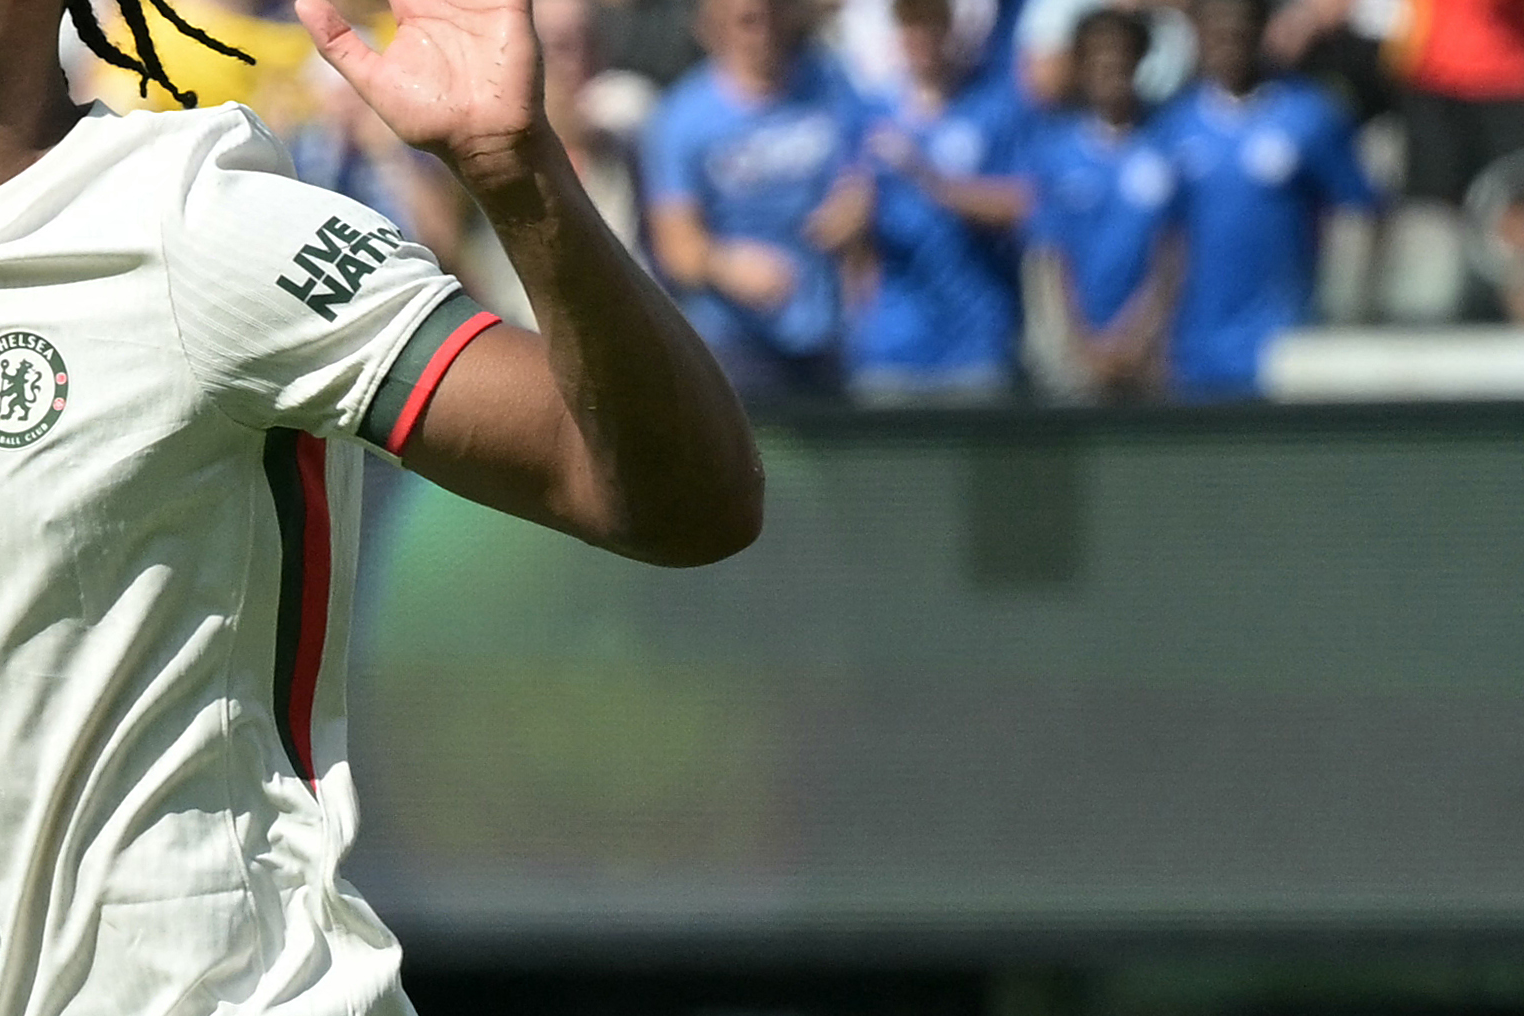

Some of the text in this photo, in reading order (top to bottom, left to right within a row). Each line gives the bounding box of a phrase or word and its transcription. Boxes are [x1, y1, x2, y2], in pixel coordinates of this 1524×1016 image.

[275, 215, 363, 303] LIVE
[305, 227, 405, 323] NATIO
[24, 422, 49, 442] CLUB
